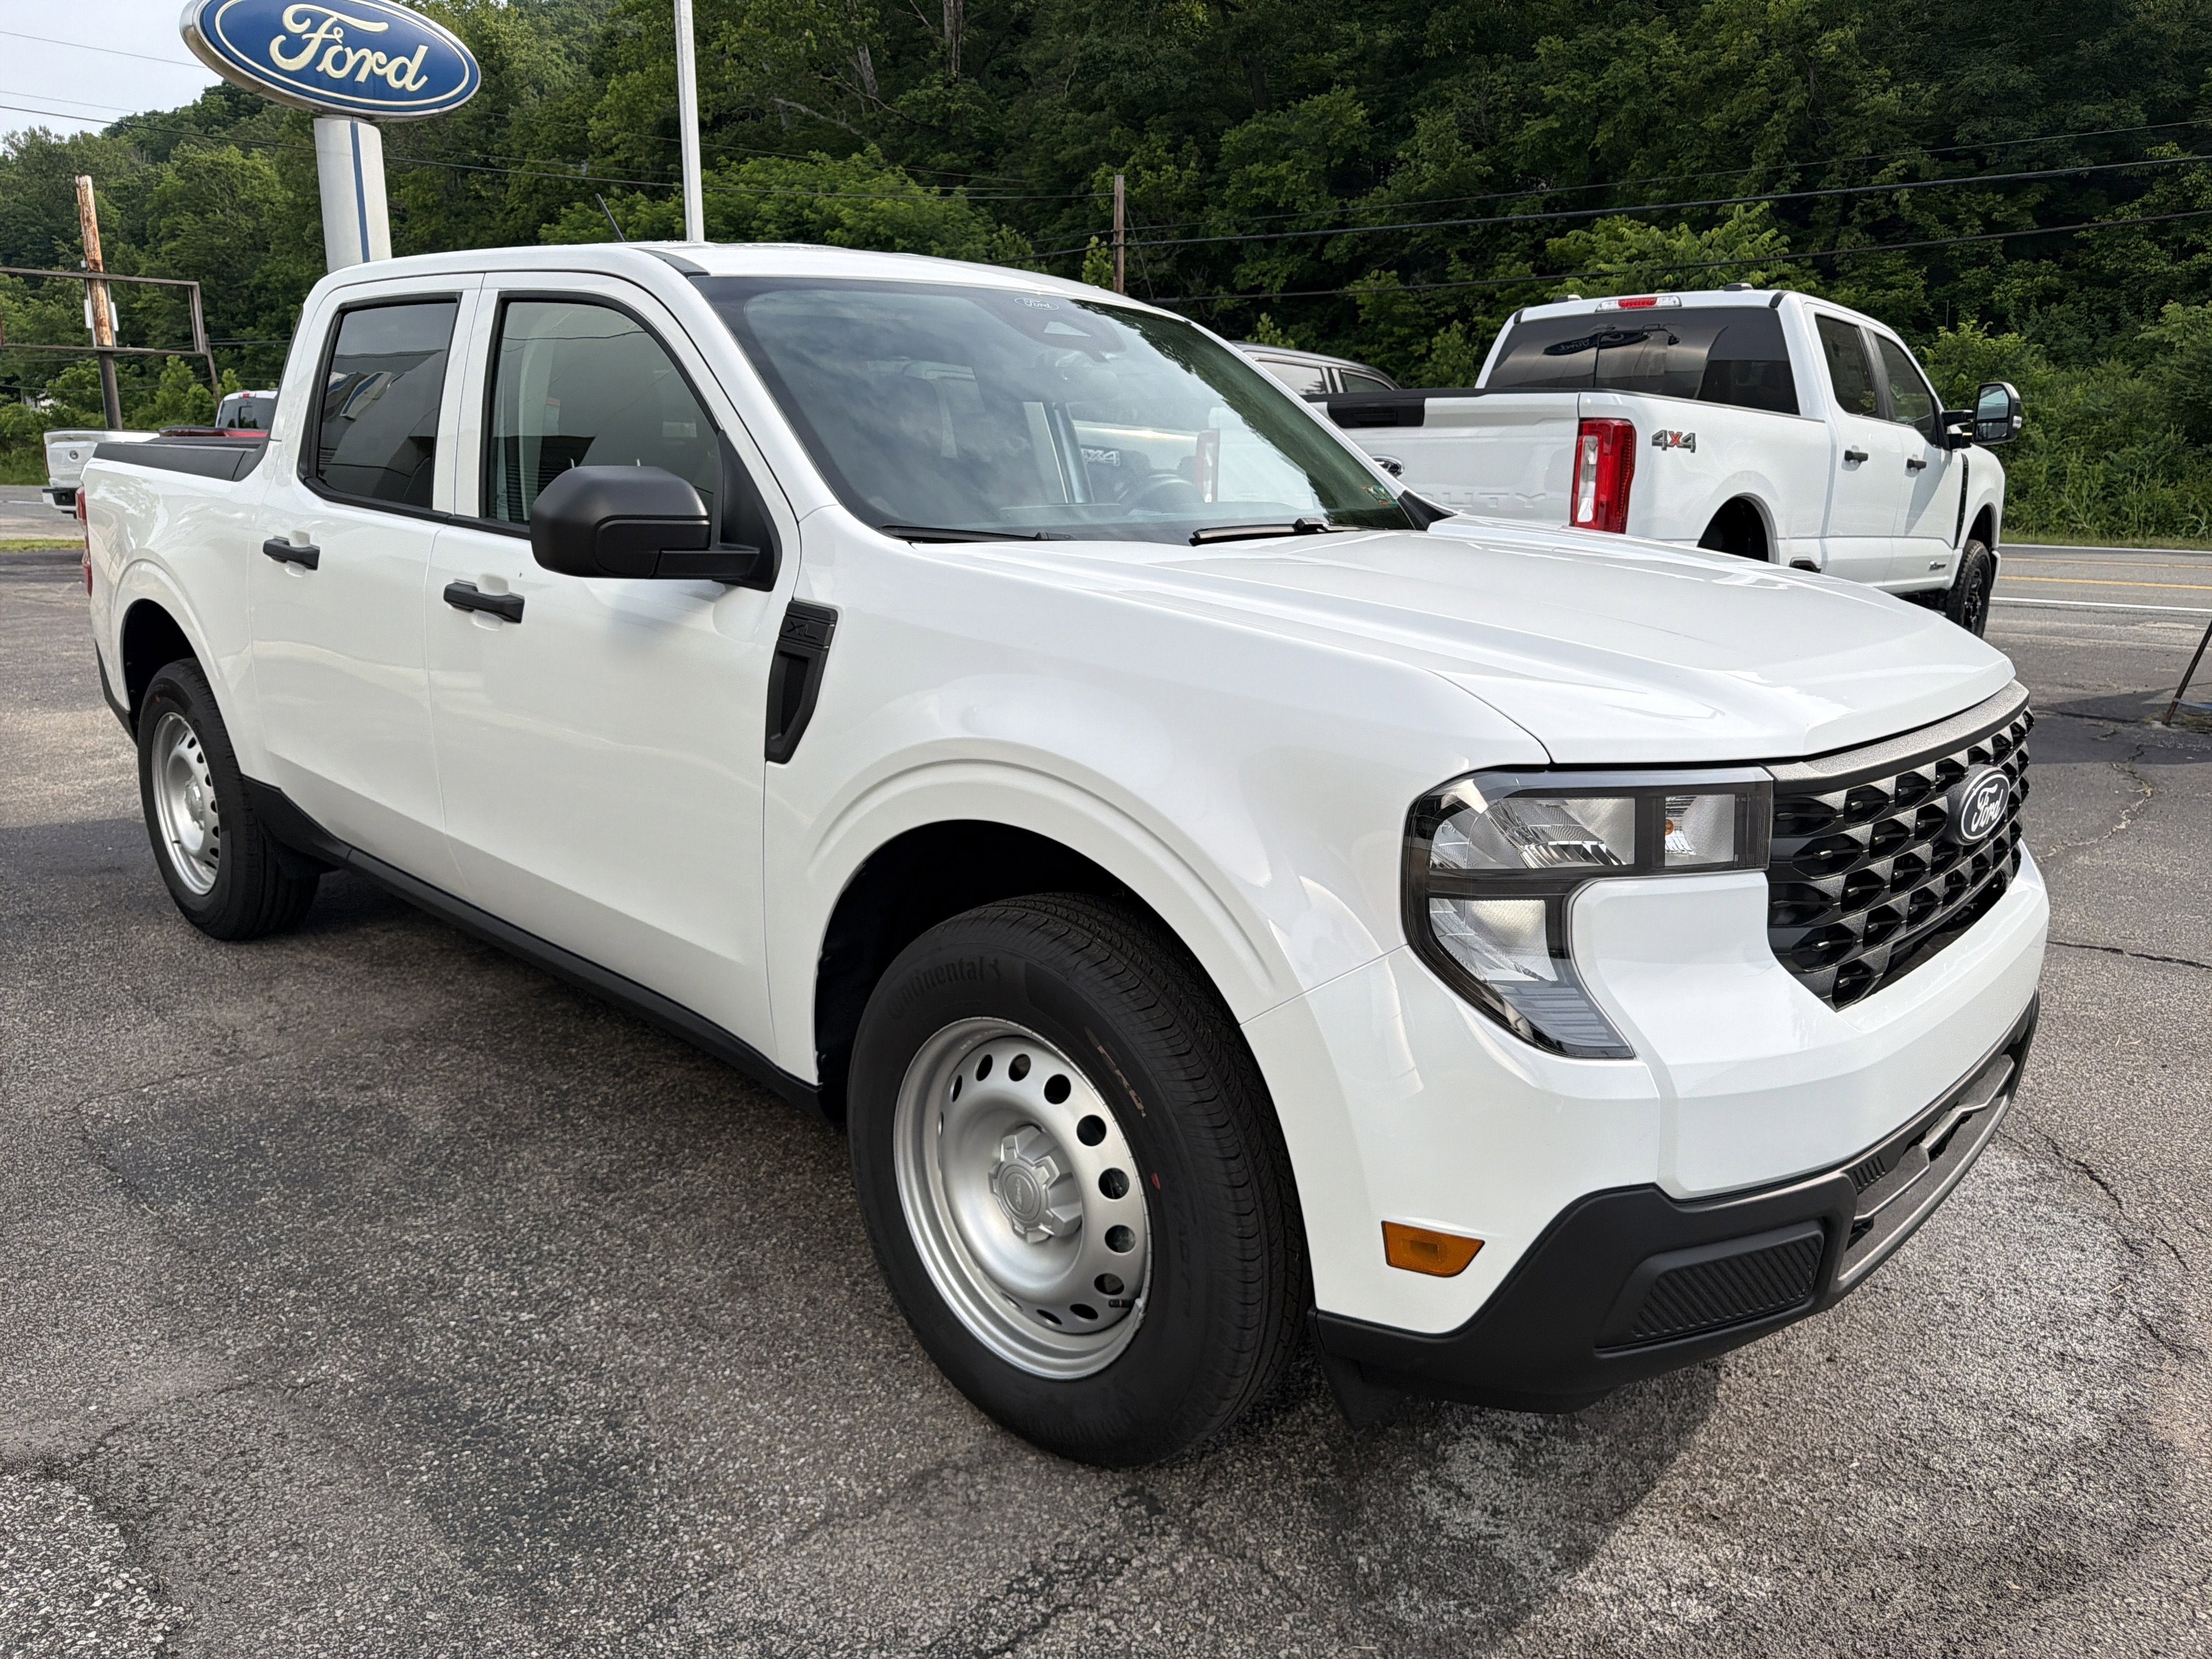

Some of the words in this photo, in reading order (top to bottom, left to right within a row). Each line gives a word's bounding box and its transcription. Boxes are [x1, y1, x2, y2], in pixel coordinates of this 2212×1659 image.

[269, 4, 430, 92] Ford
[1023, 298, 1053, 308] Ford
[786, 620, 817, 640] XL
[1971, 783, 2004, 832] Ford
